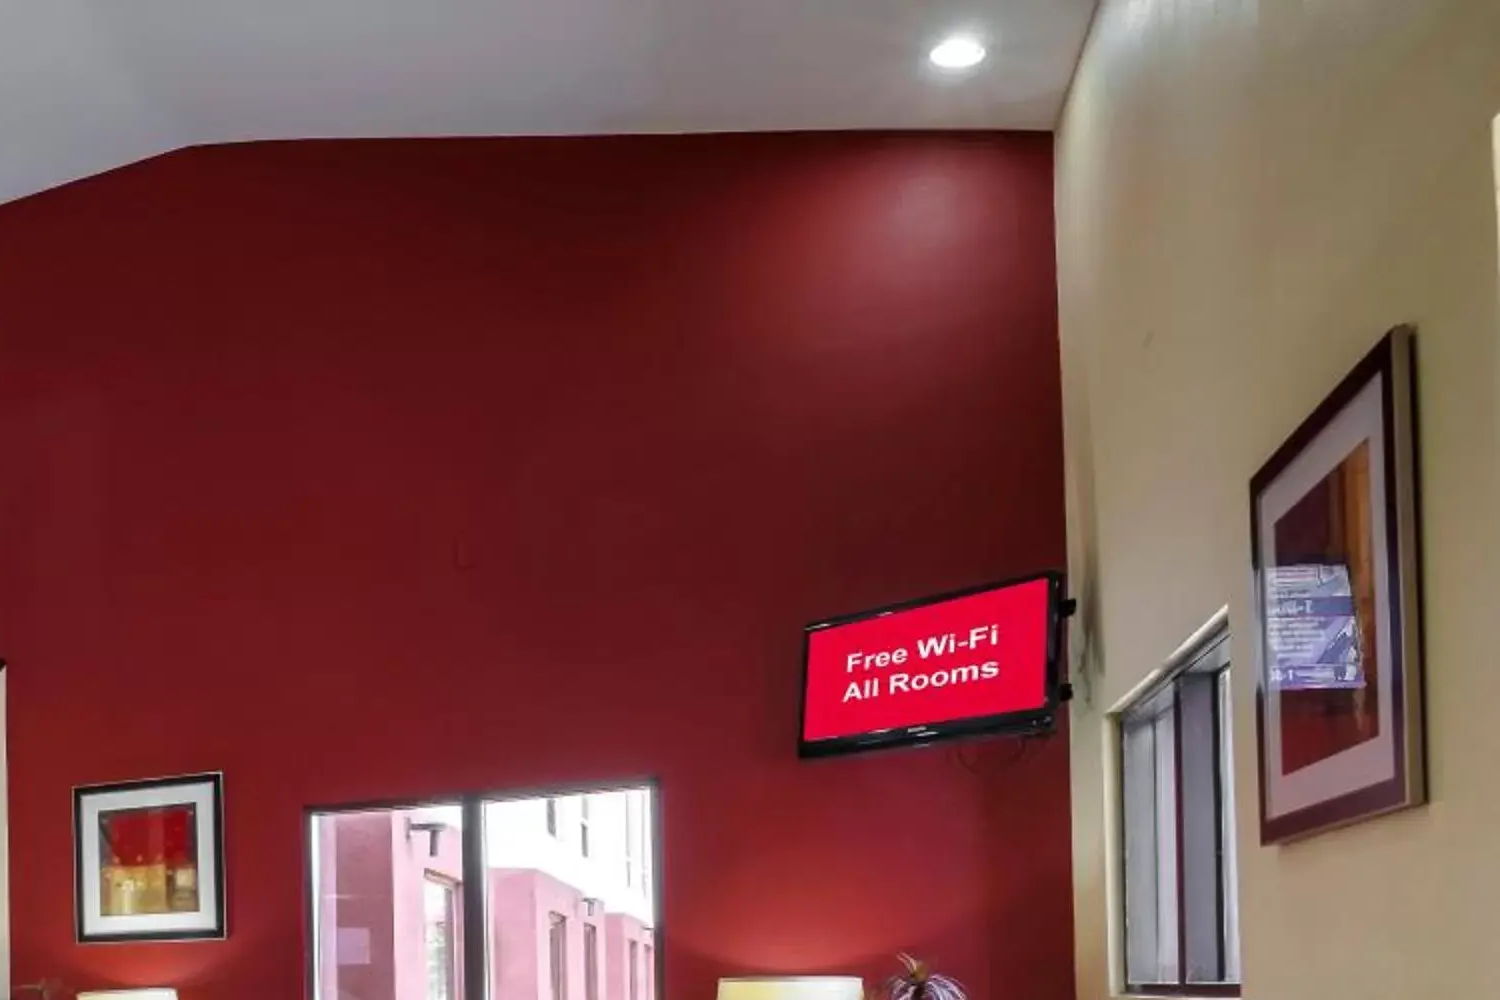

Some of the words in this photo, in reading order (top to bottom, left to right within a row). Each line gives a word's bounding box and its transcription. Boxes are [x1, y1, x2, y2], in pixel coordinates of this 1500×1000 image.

[846, 648, 908, 673] Free
[916, 624, 998, 659] Wi-Fi
[842, 677, 880, 703] All
[888, 660, 1000, 695] Rooms
